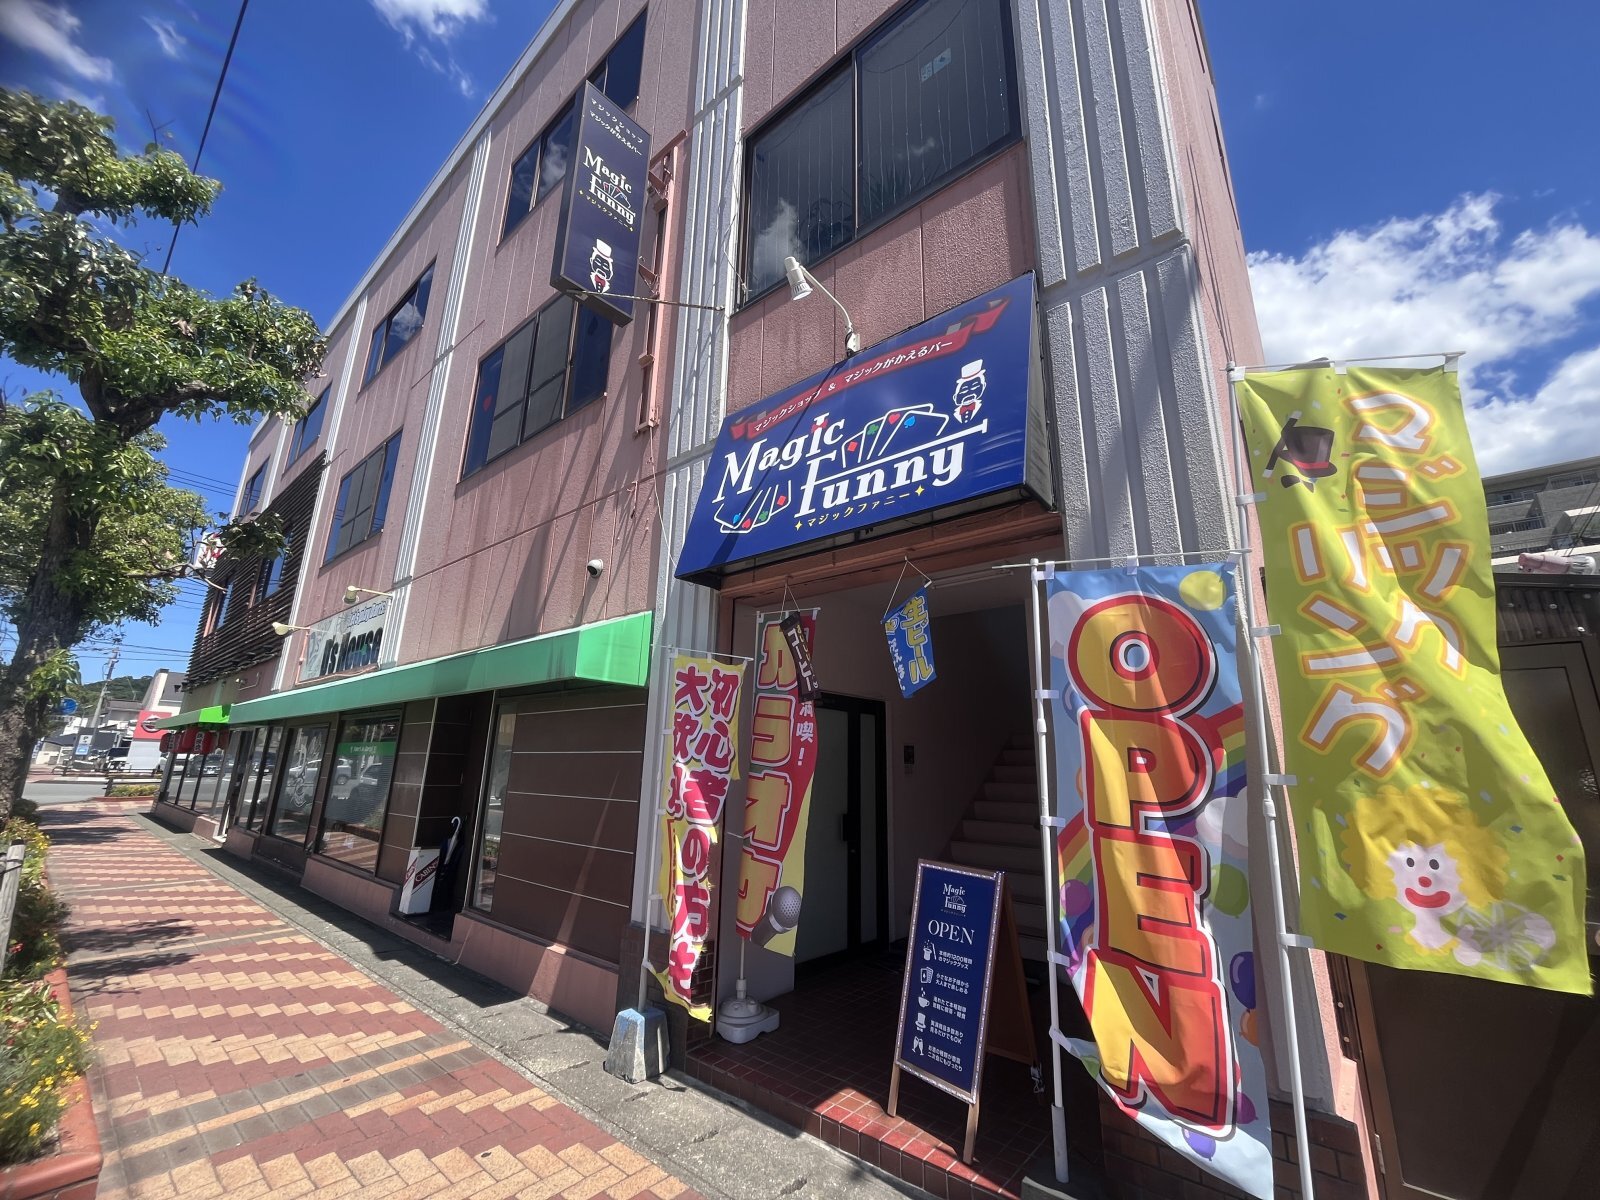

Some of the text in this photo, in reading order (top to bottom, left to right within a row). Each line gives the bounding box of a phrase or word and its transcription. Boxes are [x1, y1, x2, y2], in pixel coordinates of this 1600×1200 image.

[582, 145, 632, 193] Magic
[588, 173, 635, 225] Funny
[754, 341, 953, 432] マジックショップ & マジックがかえるバー
[712, 412, 847, 504] Magic
[794, 428, 978, 518] Funny
[807, 493, 911, 528] マジックファニー
[1346, 389, 1469, 679] マジック
[787, 627, 813, 692] コーヒー
[900, 596, 934, 684] 生ビール
[736, 620, 797, 930] カラオケ
[942, 883, 966, 895] Magic
[1065, 592, 1237, 1140] OPEN
[928, 919, 975, 945] OPEN
[944, 896, 967, 914] Funny
